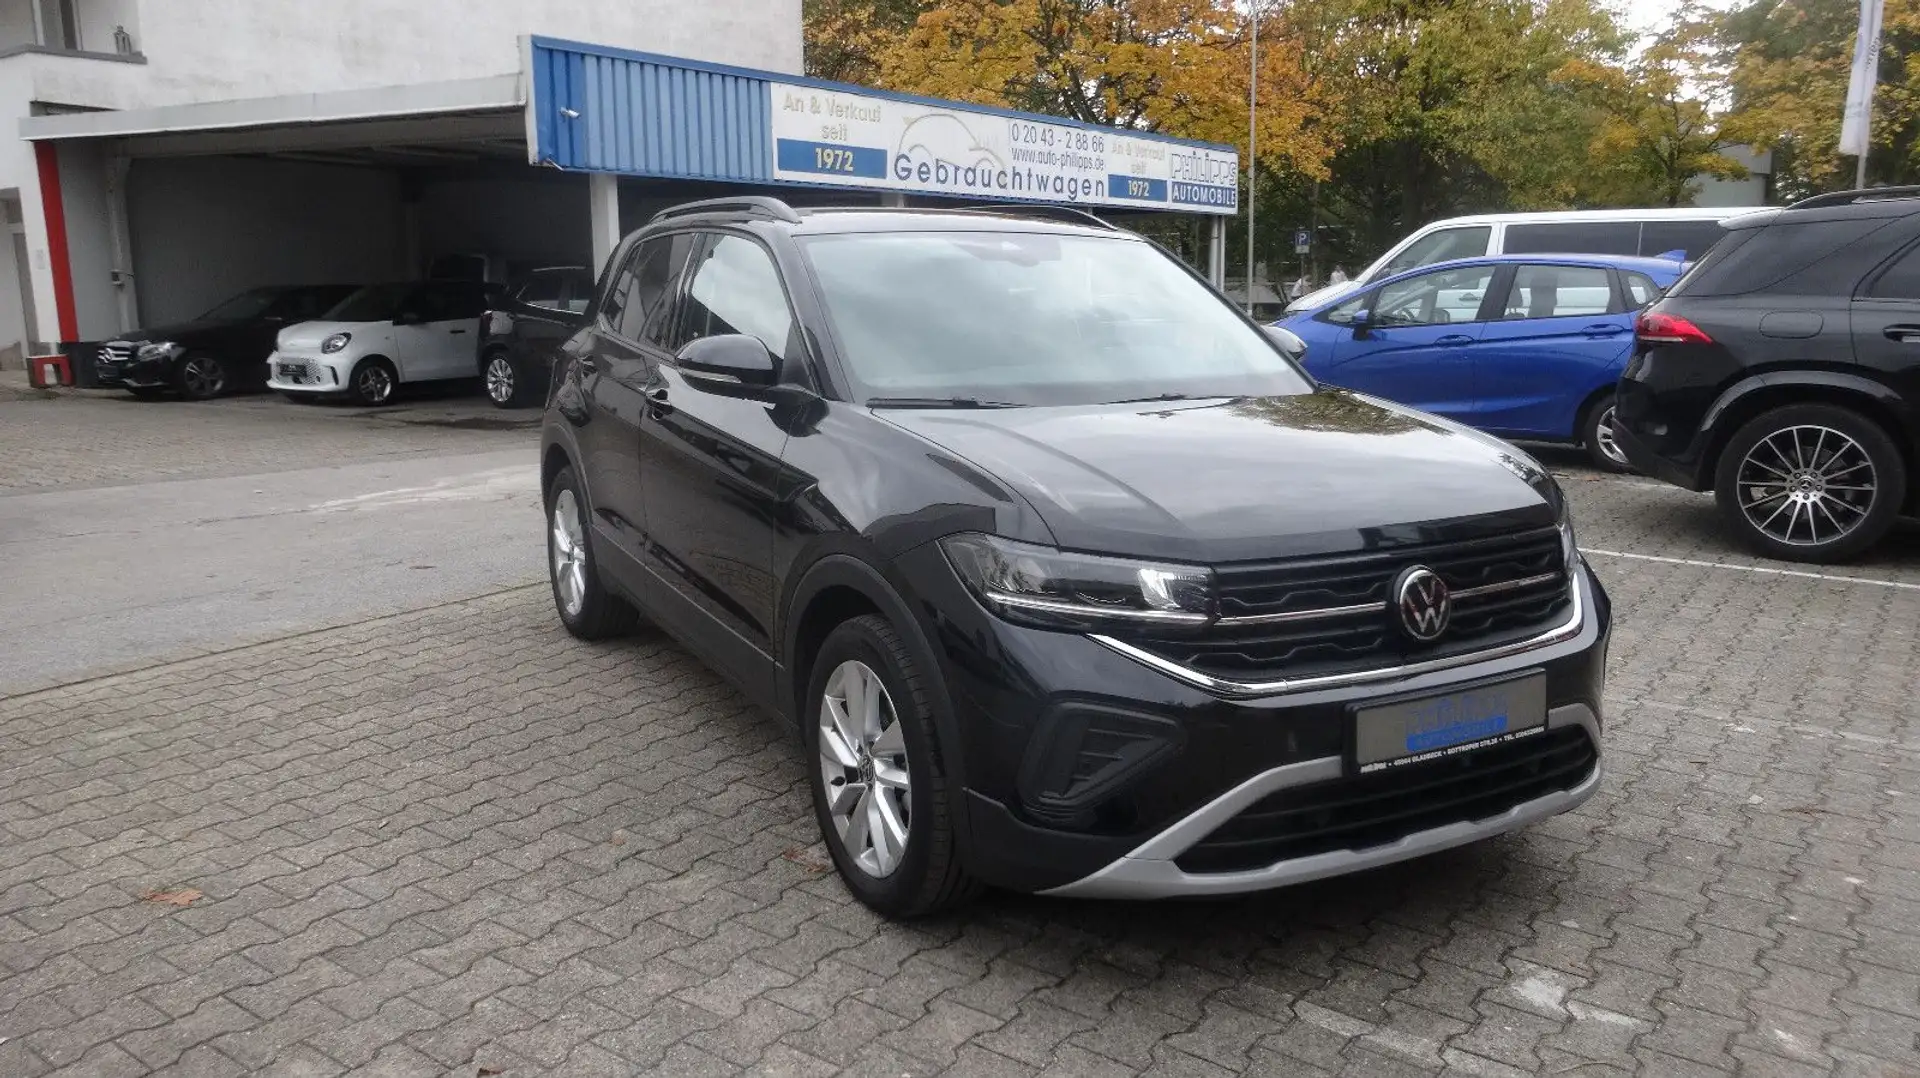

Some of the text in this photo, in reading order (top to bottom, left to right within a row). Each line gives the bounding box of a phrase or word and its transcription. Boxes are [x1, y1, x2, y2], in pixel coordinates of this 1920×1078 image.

[783, 92, 882, 122] An & Verkauf
[821, 123, 848, 141] seit
[1011, 123, 1019, 141] 0
[1023, 125, 1037, 144] 20
[1040, 128, 1054, 147] 43
[1065, 131, 1071, 149] 2
[1075, 132, 1089, 151] 88
[1092, 135, 1104, 153] 66
[815, 147, 854, 172] 1972
[1011, 147, 1104, 172] www.auto-philipps.de
[894, 153, 1105, 200] Gebrauchtwagen
[1128, 179, 1150, 197] 1972
[1172, 183, 1236, 206] AUTOMOBILE
